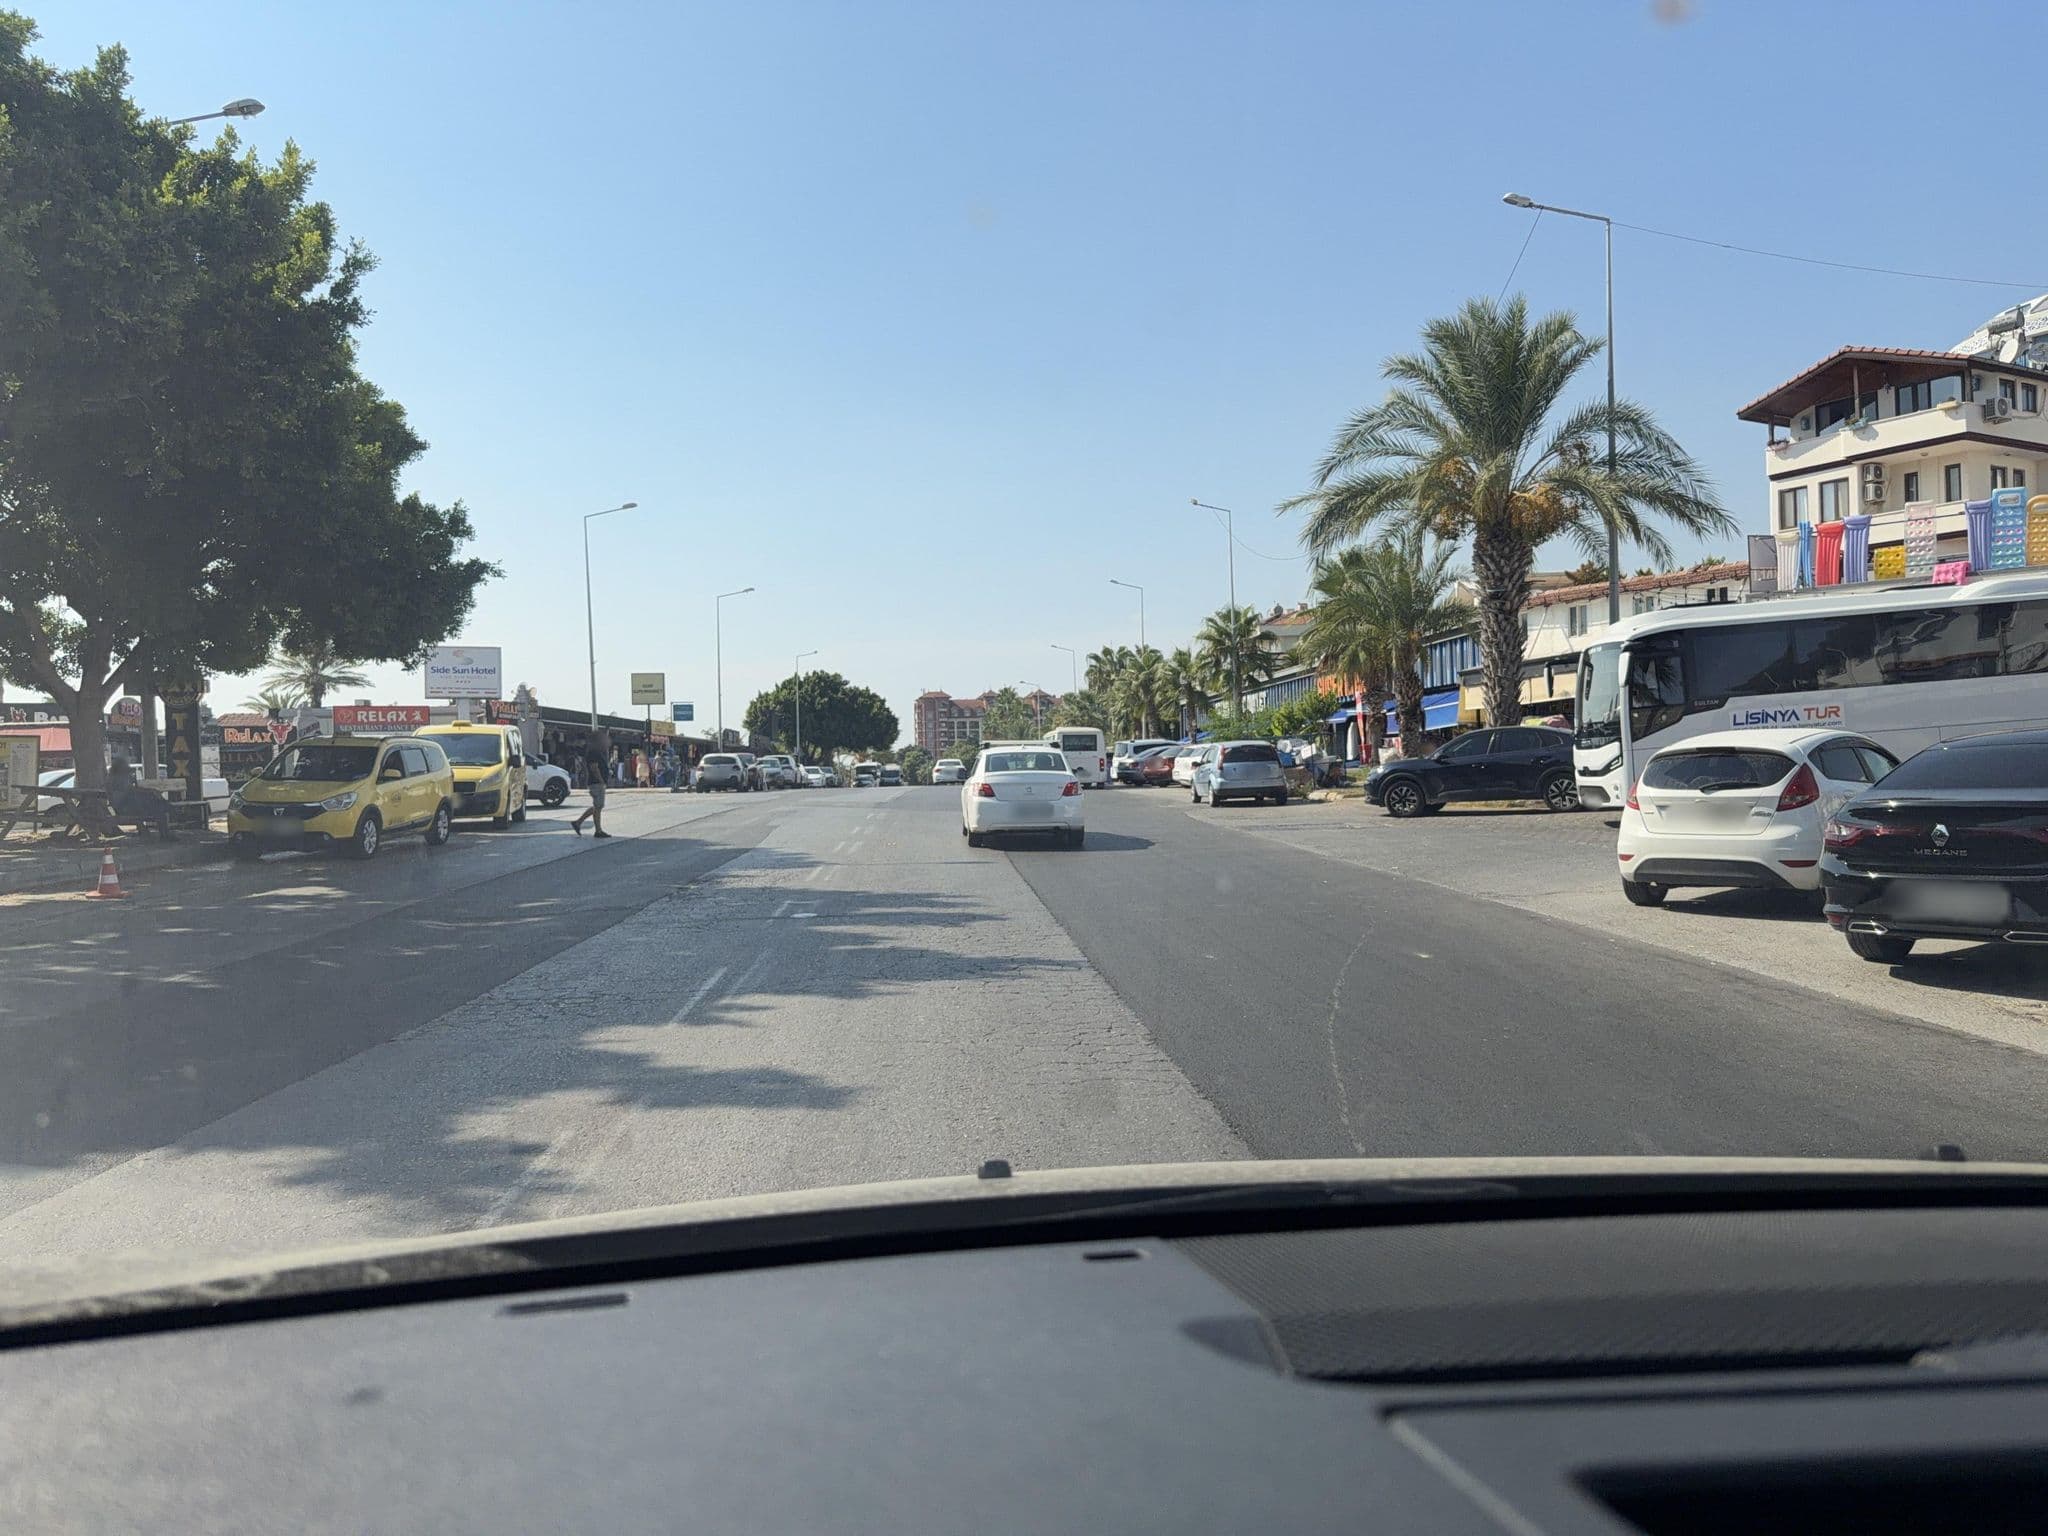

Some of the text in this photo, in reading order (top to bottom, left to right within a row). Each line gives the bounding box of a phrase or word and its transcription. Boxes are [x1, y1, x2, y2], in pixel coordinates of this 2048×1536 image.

[430, 666, 496, 675] Side Sun Hotel
[357, 710, 408, 723] RELAX
[1804, 706, 1841, 720] TUR
[1913, 848, 1968, 857] MEGANE
